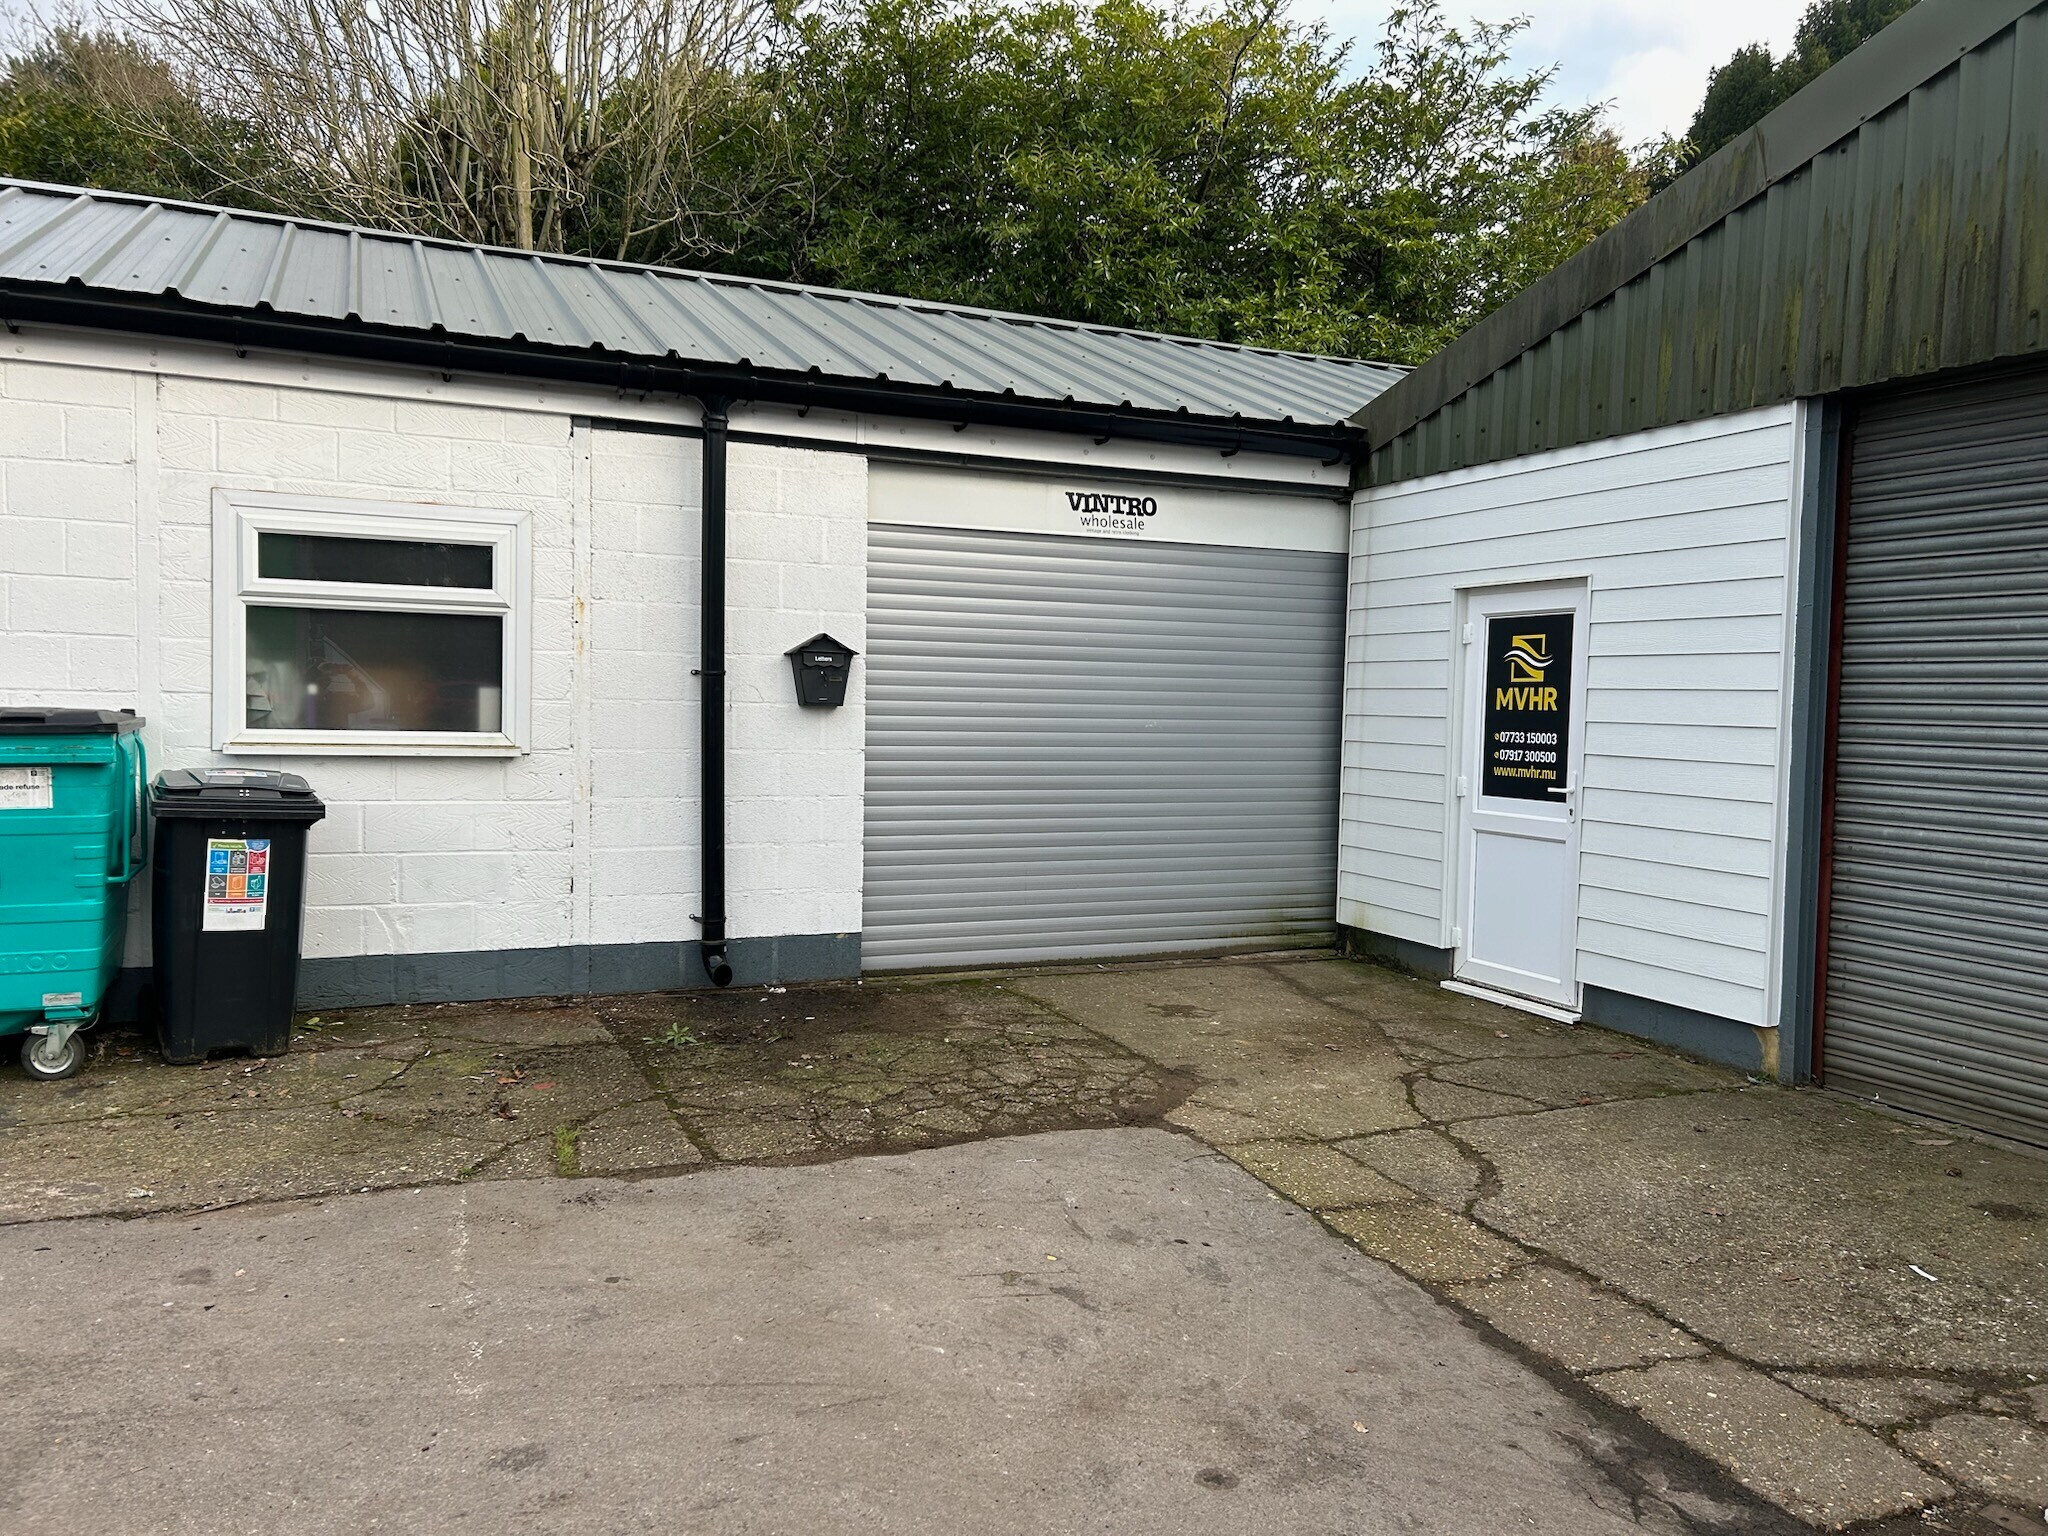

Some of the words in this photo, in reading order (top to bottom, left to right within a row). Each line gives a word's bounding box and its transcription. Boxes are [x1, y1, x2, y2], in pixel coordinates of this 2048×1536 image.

[1065, 492, 1157, 516] VINTRO
[1080, 514, 1145, 530] wholesale
[1496, 687, 1557, 711] MVHR
[1500, 731, 1525, 743] 07733
[1526, 732, 1557, 745] 150003
[1500, 749, 1523, 761] 07917
[1524, 750, 1556, 763] 300500
[1493, 765, 1557, 780] www.mvhr.mu
